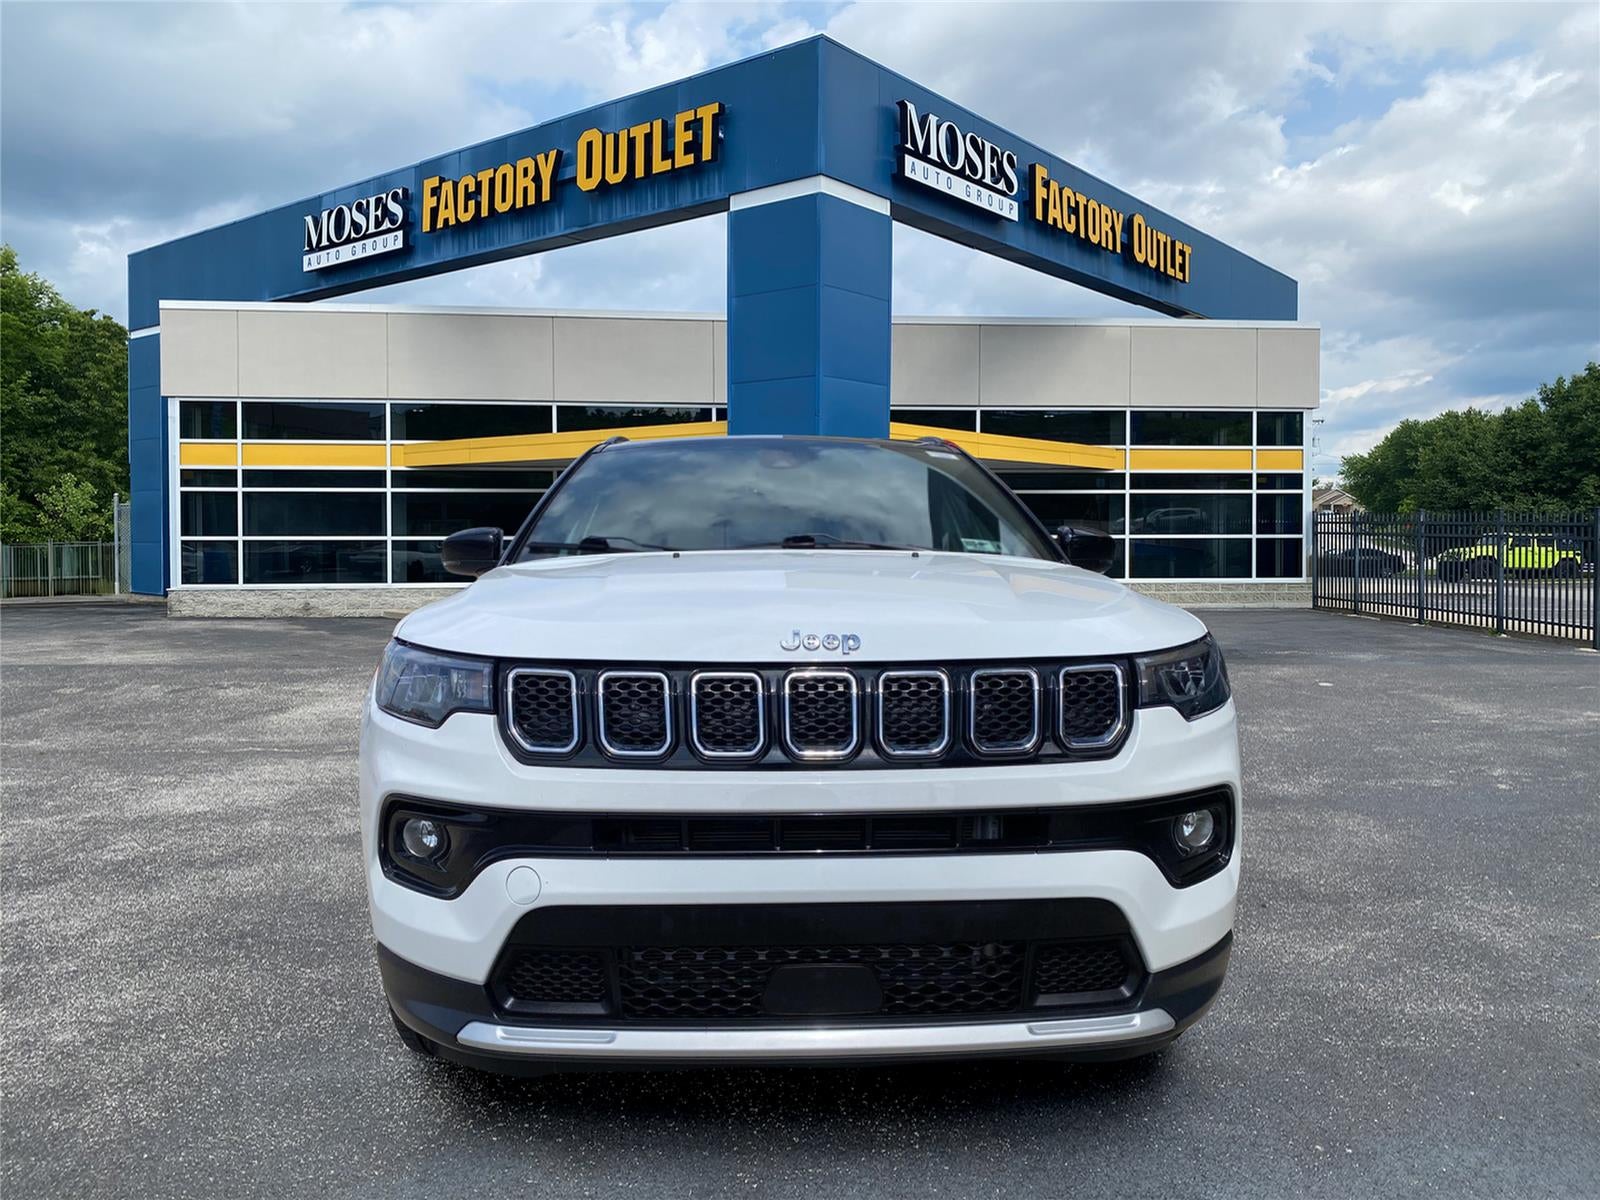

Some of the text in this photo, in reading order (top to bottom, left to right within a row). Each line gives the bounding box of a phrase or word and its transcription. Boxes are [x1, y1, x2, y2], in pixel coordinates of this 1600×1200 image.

[422, 102, 720, 233] FACTORY OUTLET
[904, 100, 1019, 196] MOSES
[303, 187, 404, 251] MOSES
[910, 161, 1014, 215] AUTO GROUP
[307, 235, 400, 269] AUTO GROUP
[1035, 163, 1192, 283] FACTORY OUTLET
[780, 629, 861, 655] Jeep
